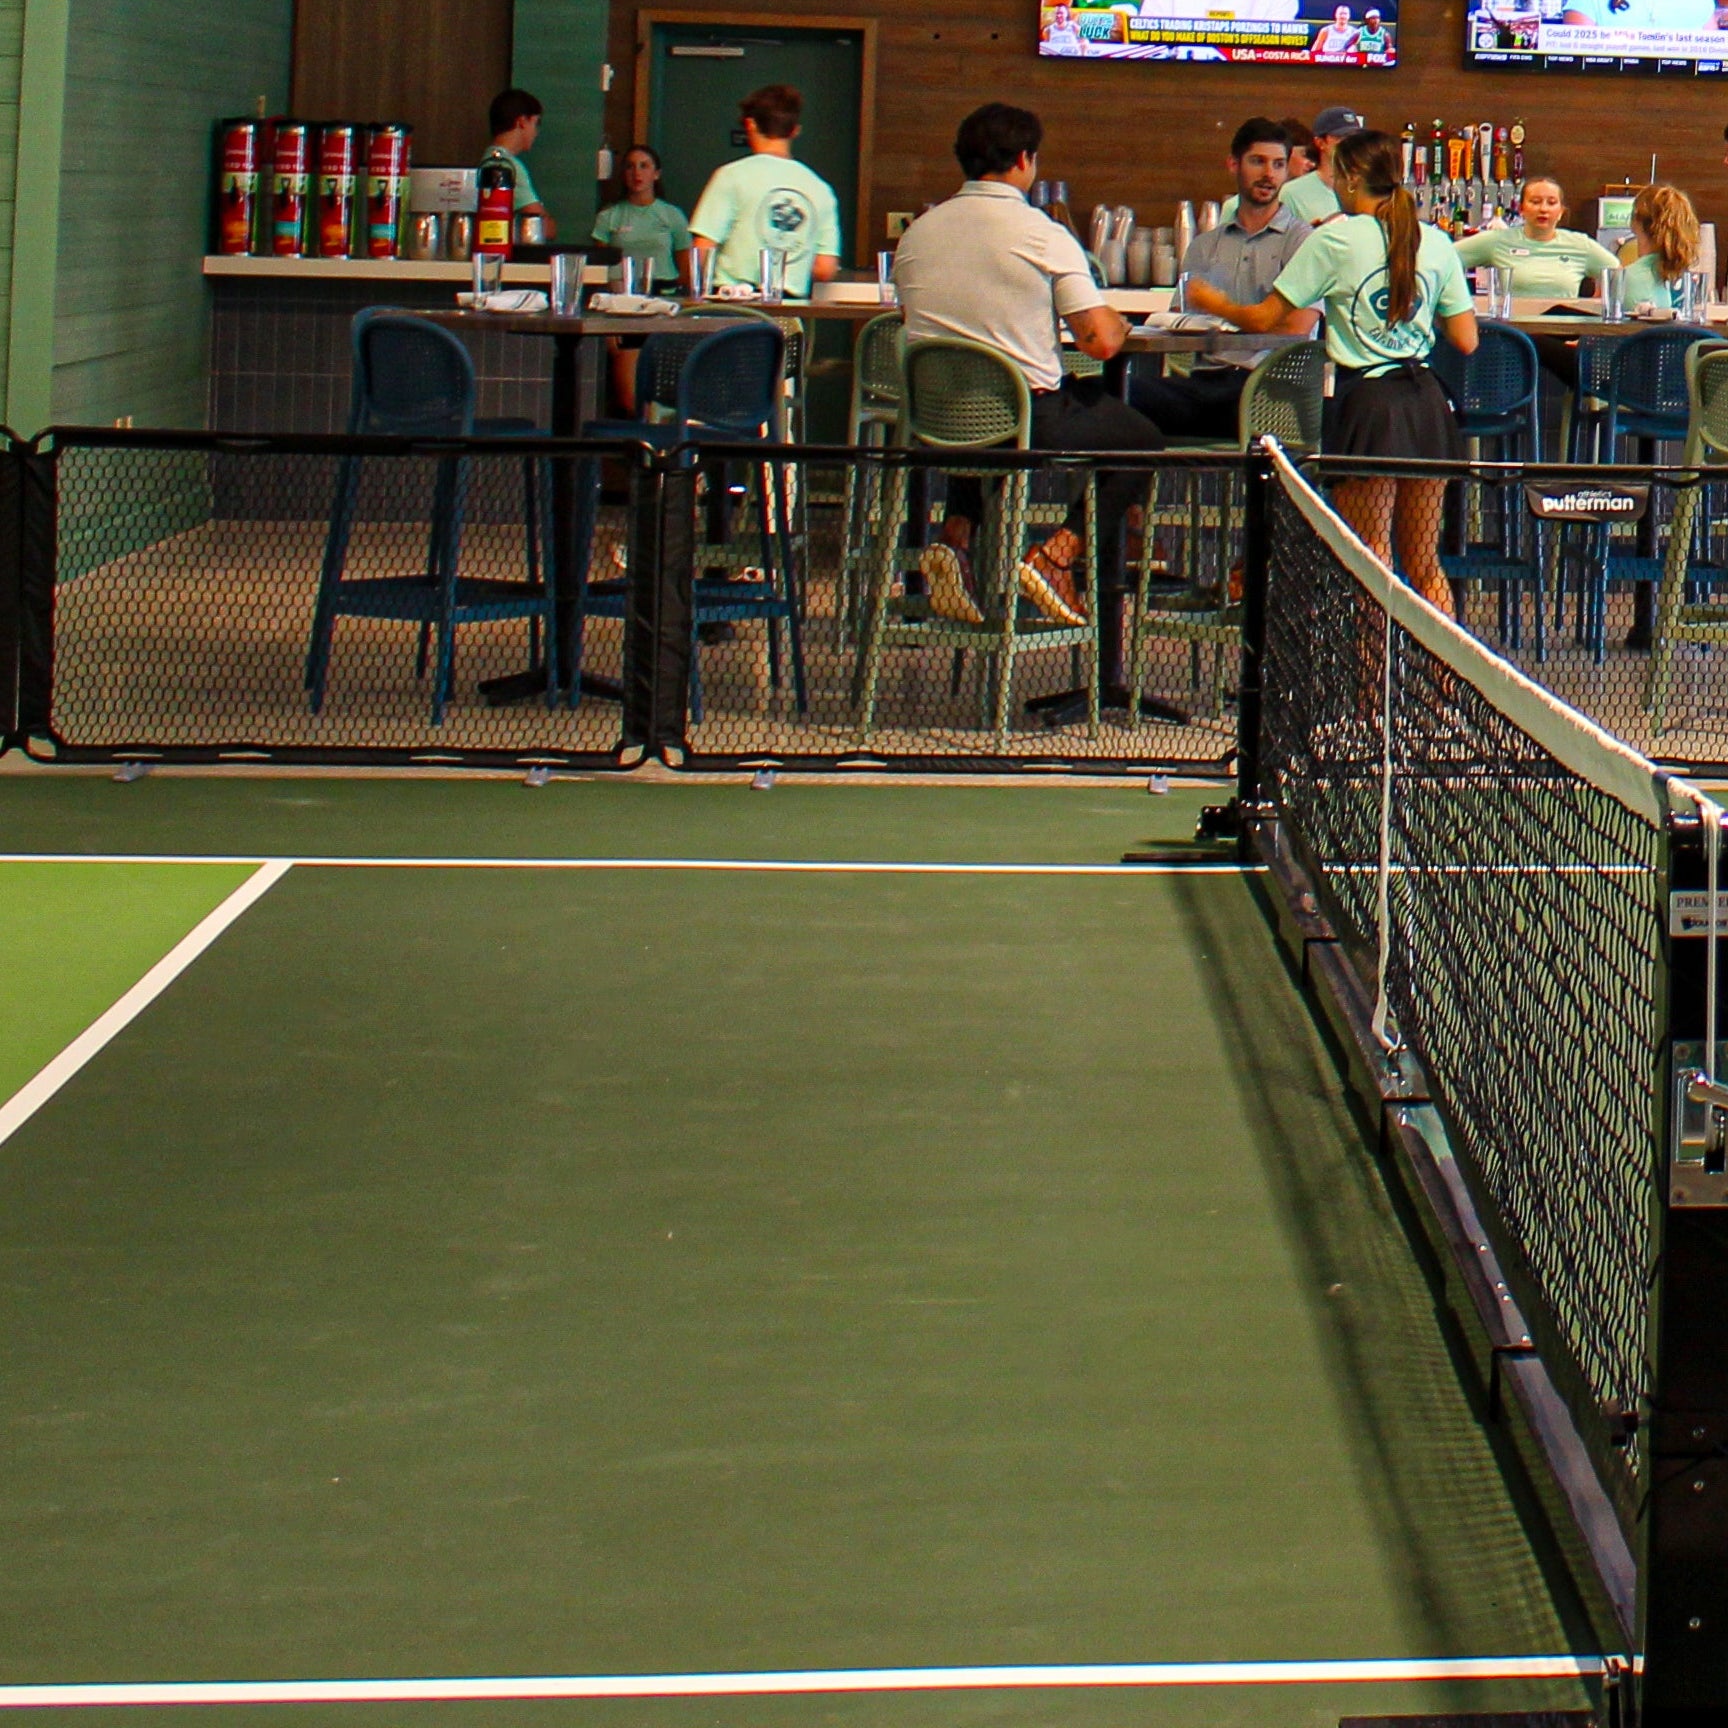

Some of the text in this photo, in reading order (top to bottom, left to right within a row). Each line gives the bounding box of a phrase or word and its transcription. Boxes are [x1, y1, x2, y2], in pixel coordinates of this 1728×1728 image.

[1575, 30, 1597, 39] 2025
[1232, 49, 1255, 60] USA
[1543, 494, 1634, 512] putterman
